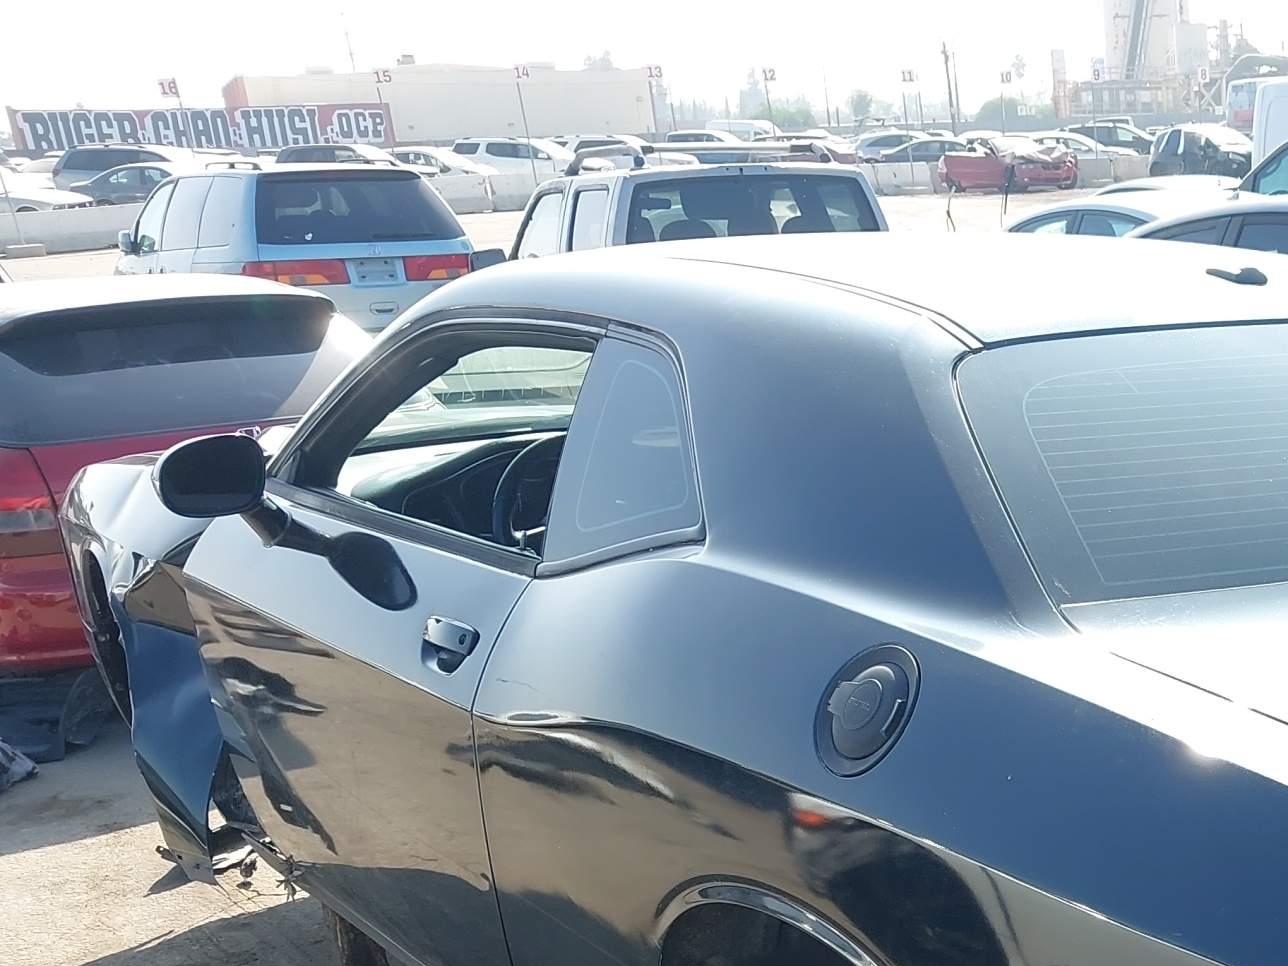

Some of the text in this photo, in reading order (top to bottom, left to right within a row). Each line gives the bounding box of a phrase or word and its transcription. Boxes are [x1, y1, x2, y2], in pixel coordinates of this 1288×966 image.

[373, 70, 392, 84] 15
[514, 66, 530, 79] 14
[647, 66, 663, 78] 13
[763, 68, 777, 81] 12
[901, 71, 914, 82] 11
[1000, 71, 1012, 83] 10
[1093, 68, 1100, 81] 9
[1200, 68, 1207, 81] 8
[158, 81, 179, 95] 16
